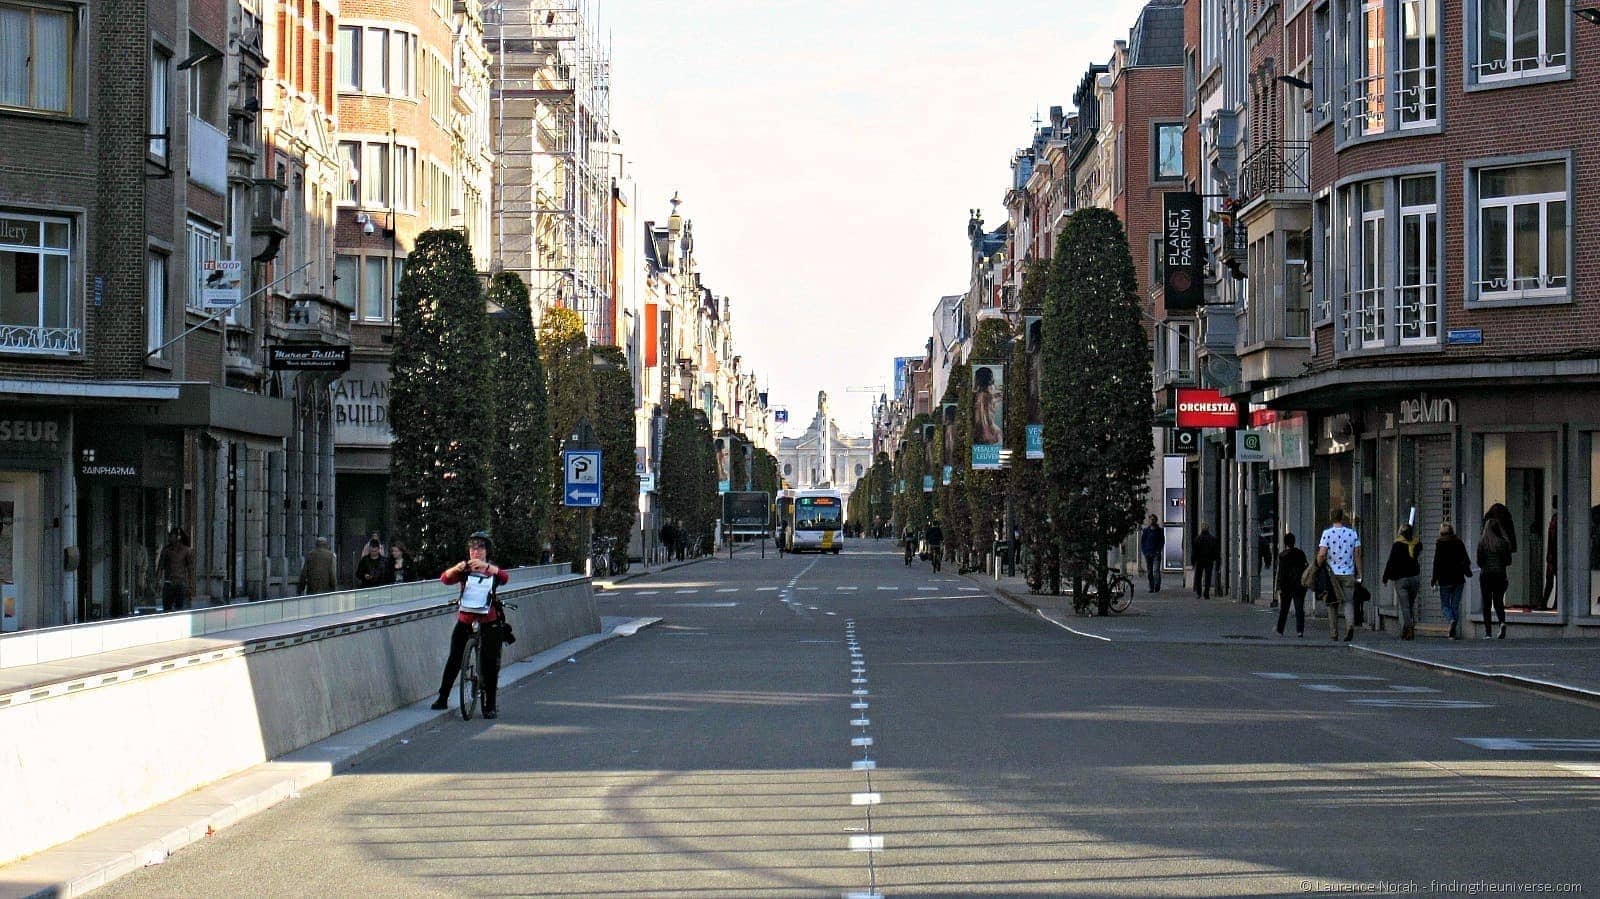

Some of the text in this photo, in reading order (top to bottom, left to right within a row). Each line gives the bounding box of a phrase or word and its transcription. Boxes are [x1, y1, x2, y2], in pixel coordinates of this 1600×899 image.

[1168, 209, 1180, 266] PLANET
[1180, 209, 1192, 266] PARFUM
[204, 262, 240, 270] TE KOOP
[1179, 402, 1237, 412] ORCHESTRA
[1399, 391, 1457, 424] melvin
[0, 419, 59, 442] SEUR
[82, 465, 136, 476] RAINPHARMA
[575, 462, 588, 480] P
